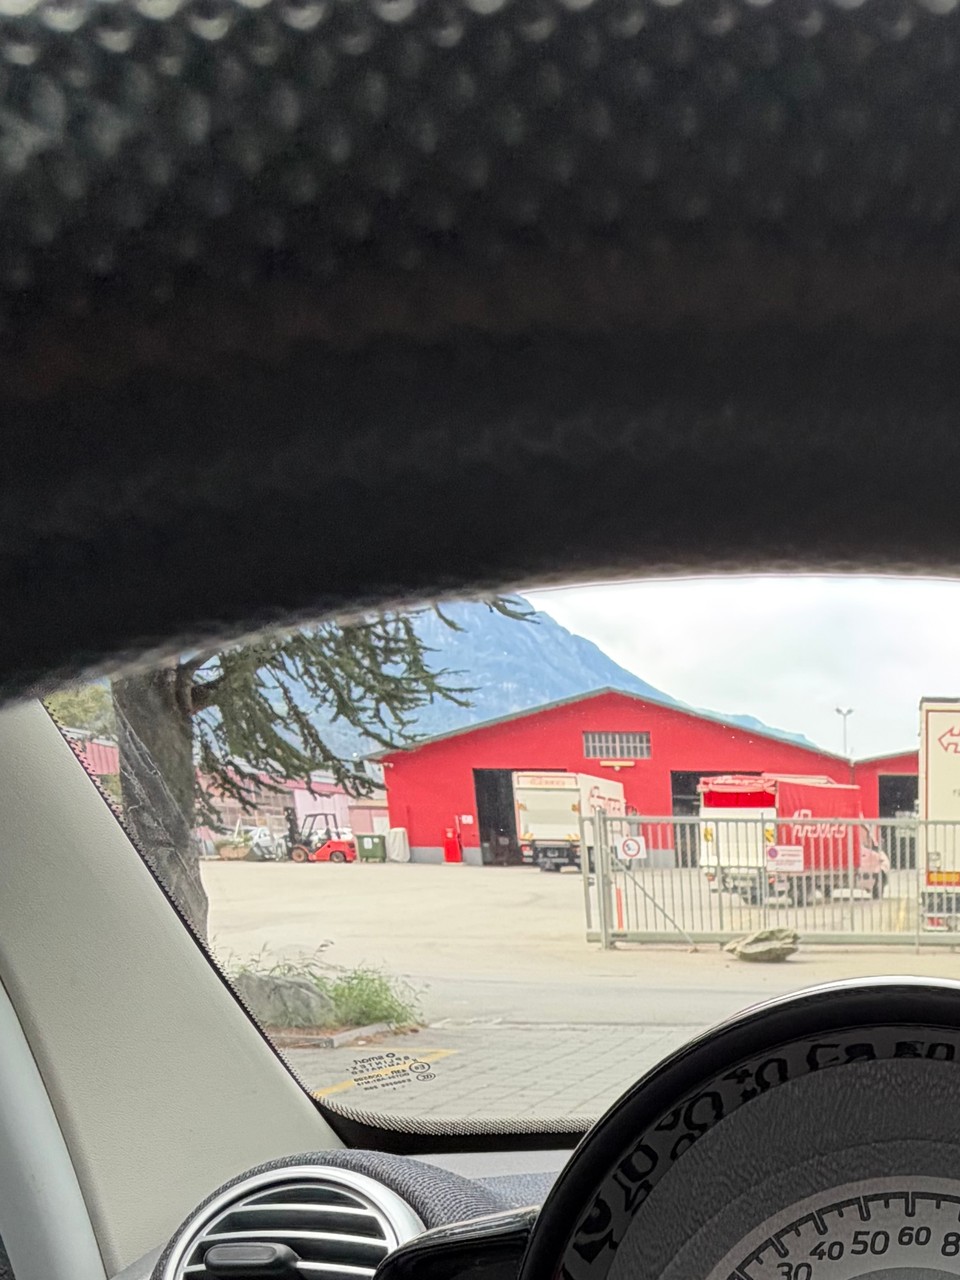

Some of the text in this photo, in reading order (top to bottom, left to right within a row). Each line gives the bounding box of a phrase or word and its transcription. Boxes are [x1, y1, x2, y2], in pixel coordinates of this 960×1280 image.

[851, 1231, 890, 1255] 50
[898, 1226, 931, 1245] 60
[809, 1241, 844, 1260] 40
